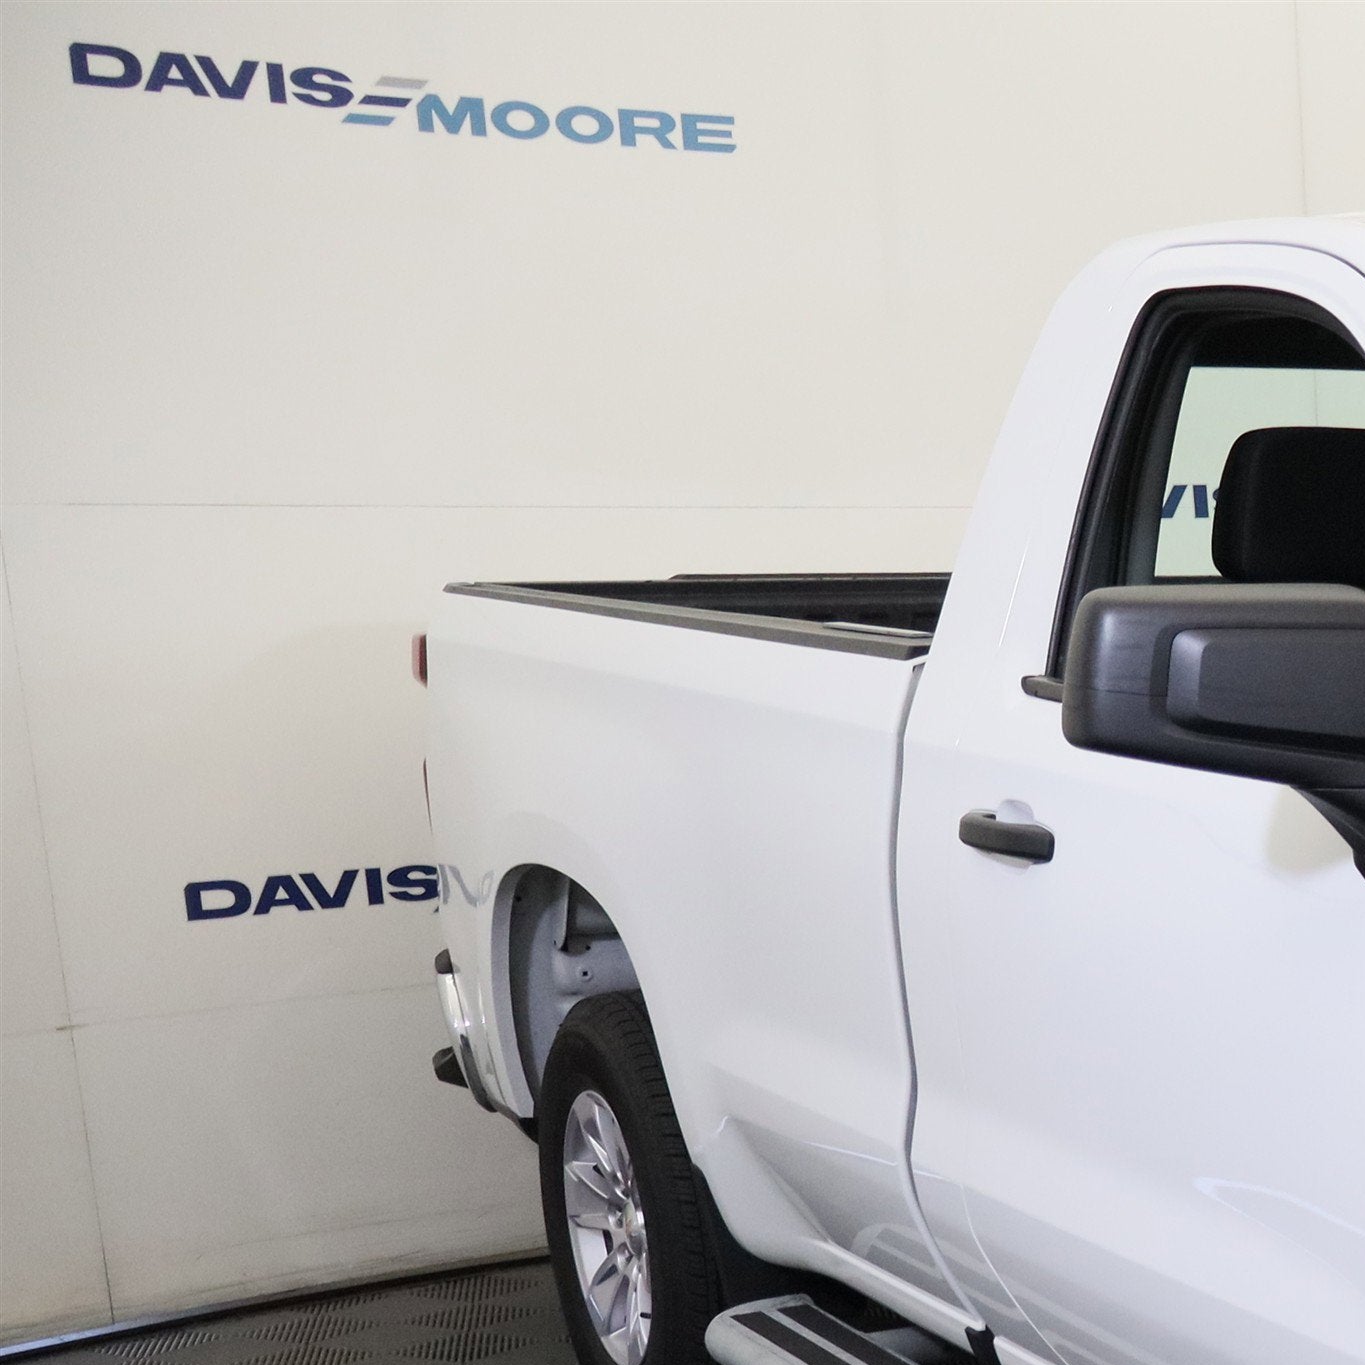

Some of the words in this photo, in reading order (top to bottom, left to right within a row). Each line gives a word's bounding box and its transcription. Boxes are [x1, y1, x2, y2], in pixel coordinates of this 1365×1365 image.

[68, 42, 355, 109] DAVIS
[416, 94, 738, 154] MOORE
[184, 864, 440, 922] DAVIS
